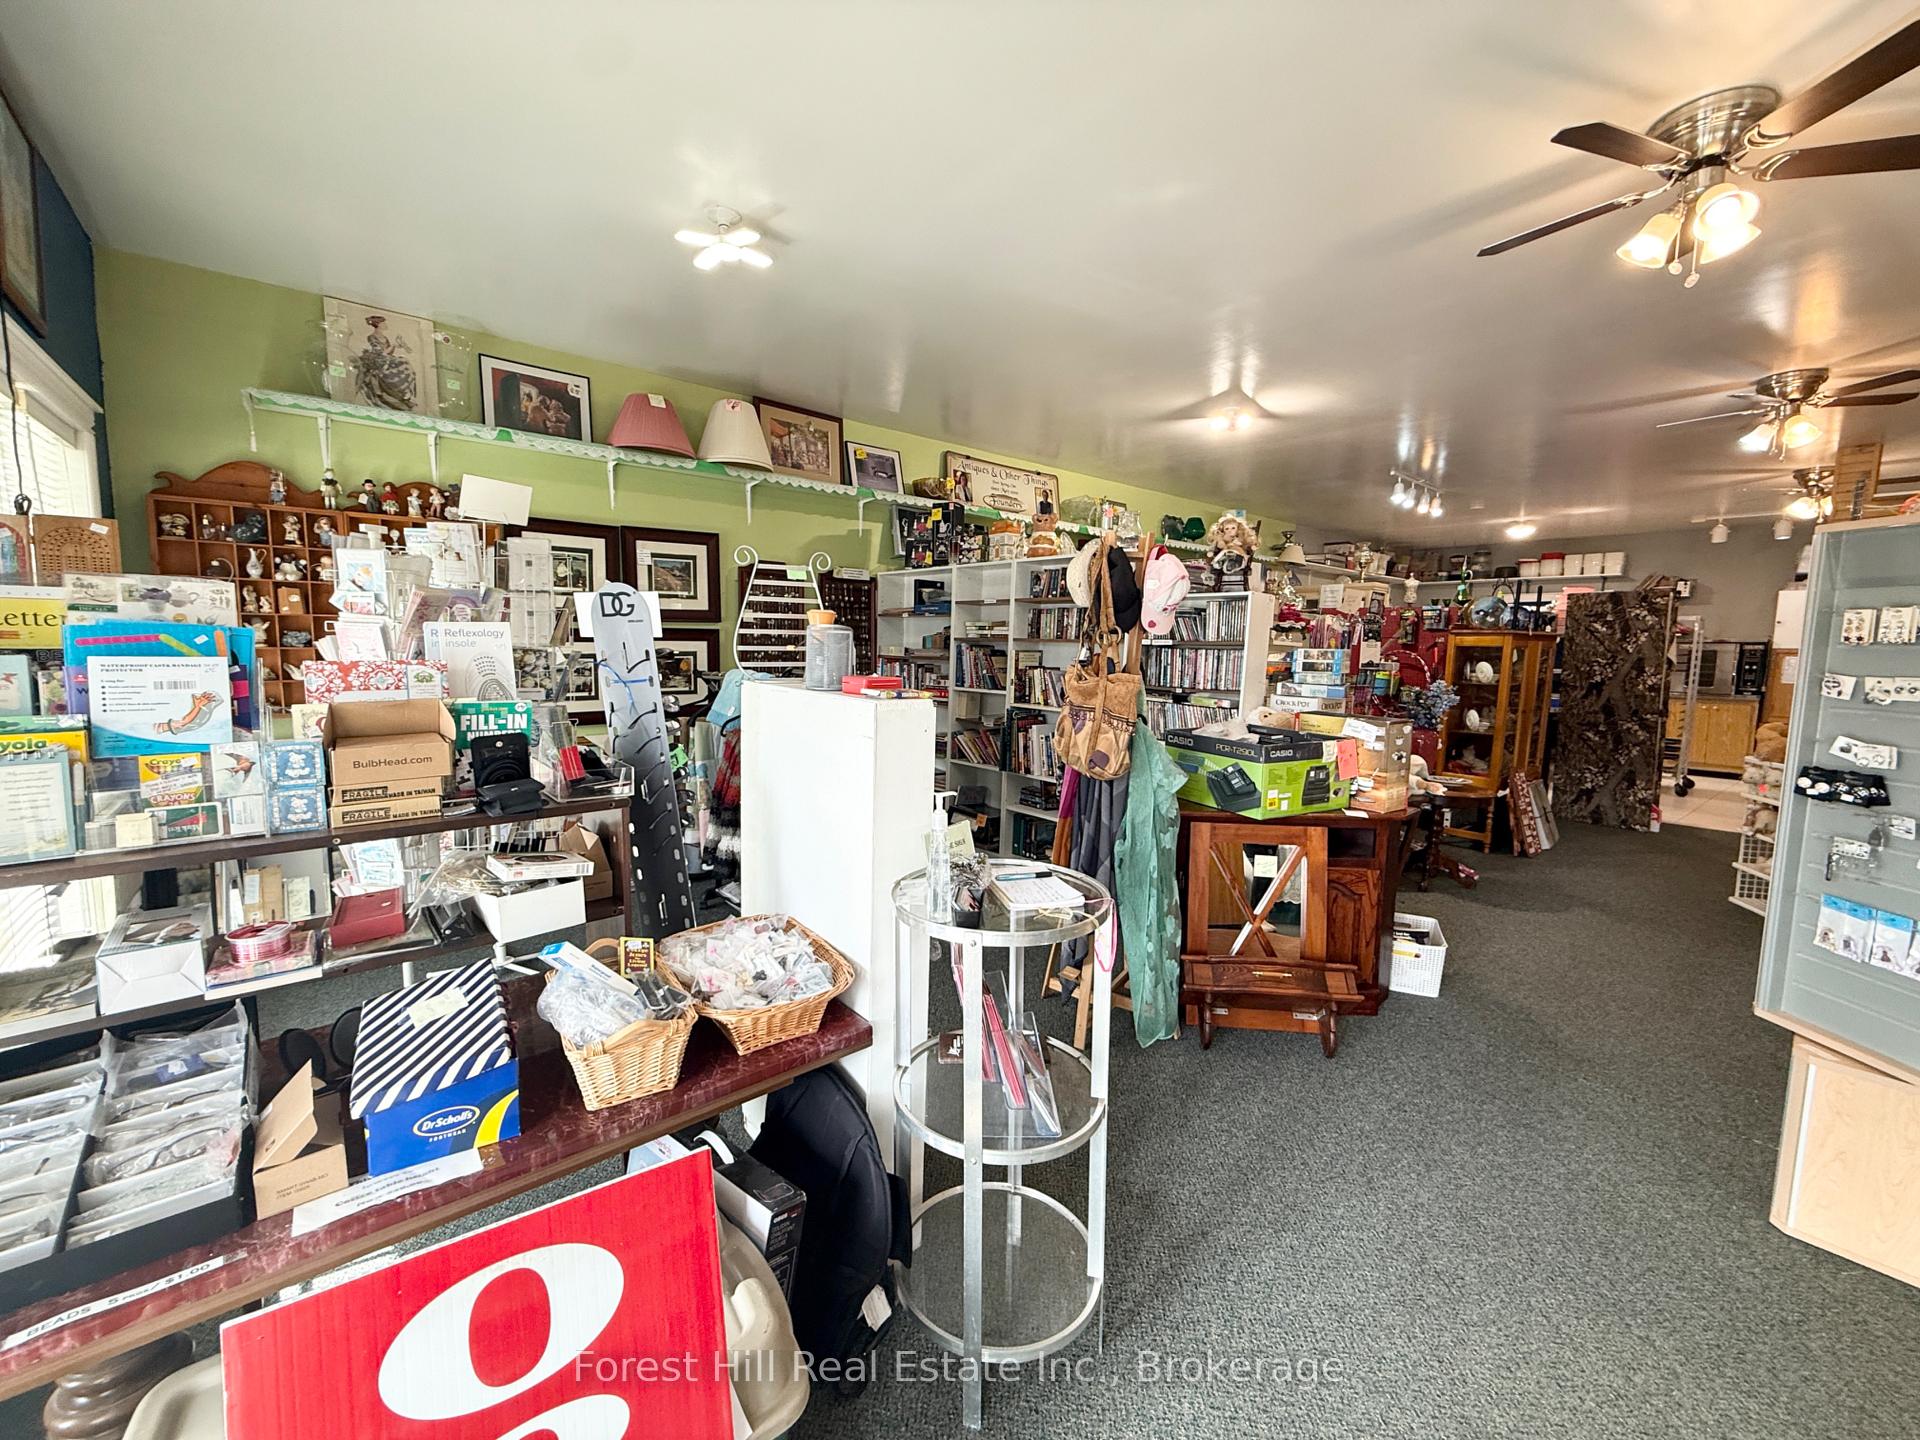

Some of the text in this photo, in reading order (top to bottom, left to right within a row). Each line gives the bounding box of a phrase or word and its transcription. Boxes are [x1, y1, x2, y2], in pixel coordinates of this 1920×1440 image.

[957, 460, 990, 476] Antiques
[990, 467, 998, 478] &
[1000, 468, 1020, 481] Other
[1023, 474, 1049, 486] Things
[991, 495, 1023, 509] Founders
[599, 591, 635, 617] DG
[444, 628, 505, 639] Reflexology
[445, 640, 477, 648] insole
[460, 713, 528, 731] FILL-IN
[467, 730, 522, 742] NUMB
[1167, 734, 1194, 747] CASIO
[1269, 750, 1294, 758] CASIO
[149, 757, 184, 766] Crayo
[353, 756, 433, 769] BulbHead.com
[150, 793, 197, 804] CRAYONS
[342, 787, 389, 801] FRAGILE
[342, 808, 391, 822] FRAGILE
[429, 1128, 467, 1143] FOOTWEAR
[26, 1308, 92, 1338] BEADS
[107, 1297, 119, 1306] 5
[165, 1263, 211, 1285] $1.00
